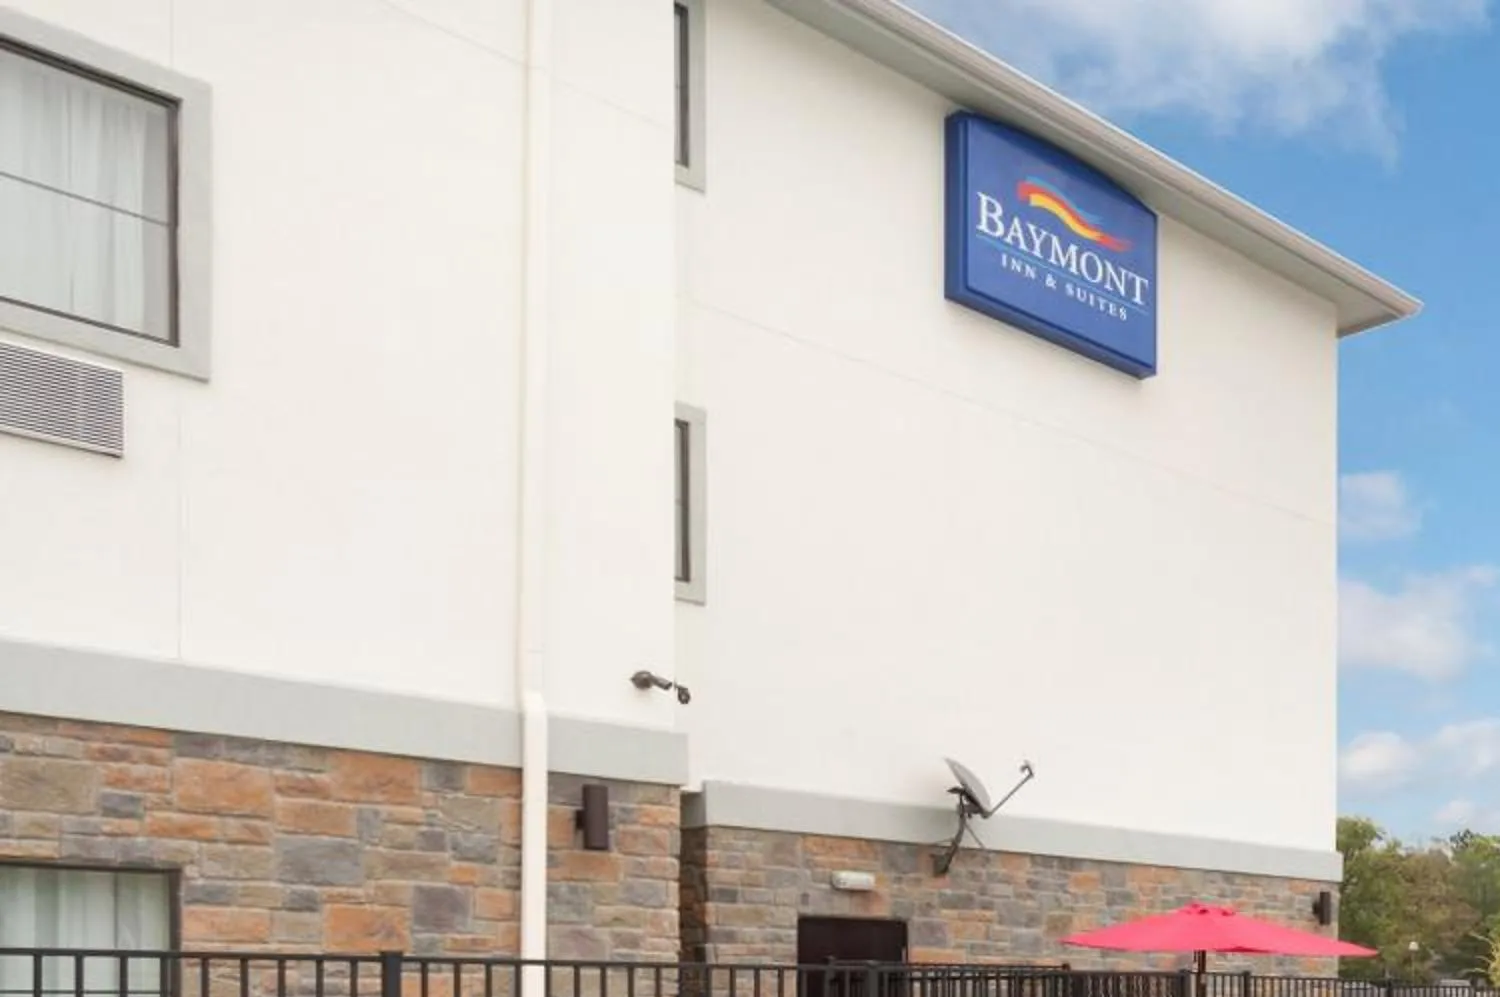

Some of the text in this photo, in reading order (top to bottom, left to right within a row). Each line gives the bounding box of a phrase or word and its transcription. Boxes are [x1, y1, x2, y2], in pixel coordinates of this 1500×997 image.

[975, 191, 1149, 306] BAYMONT
[1001, 253, 1128, 321] INN & SUITES
